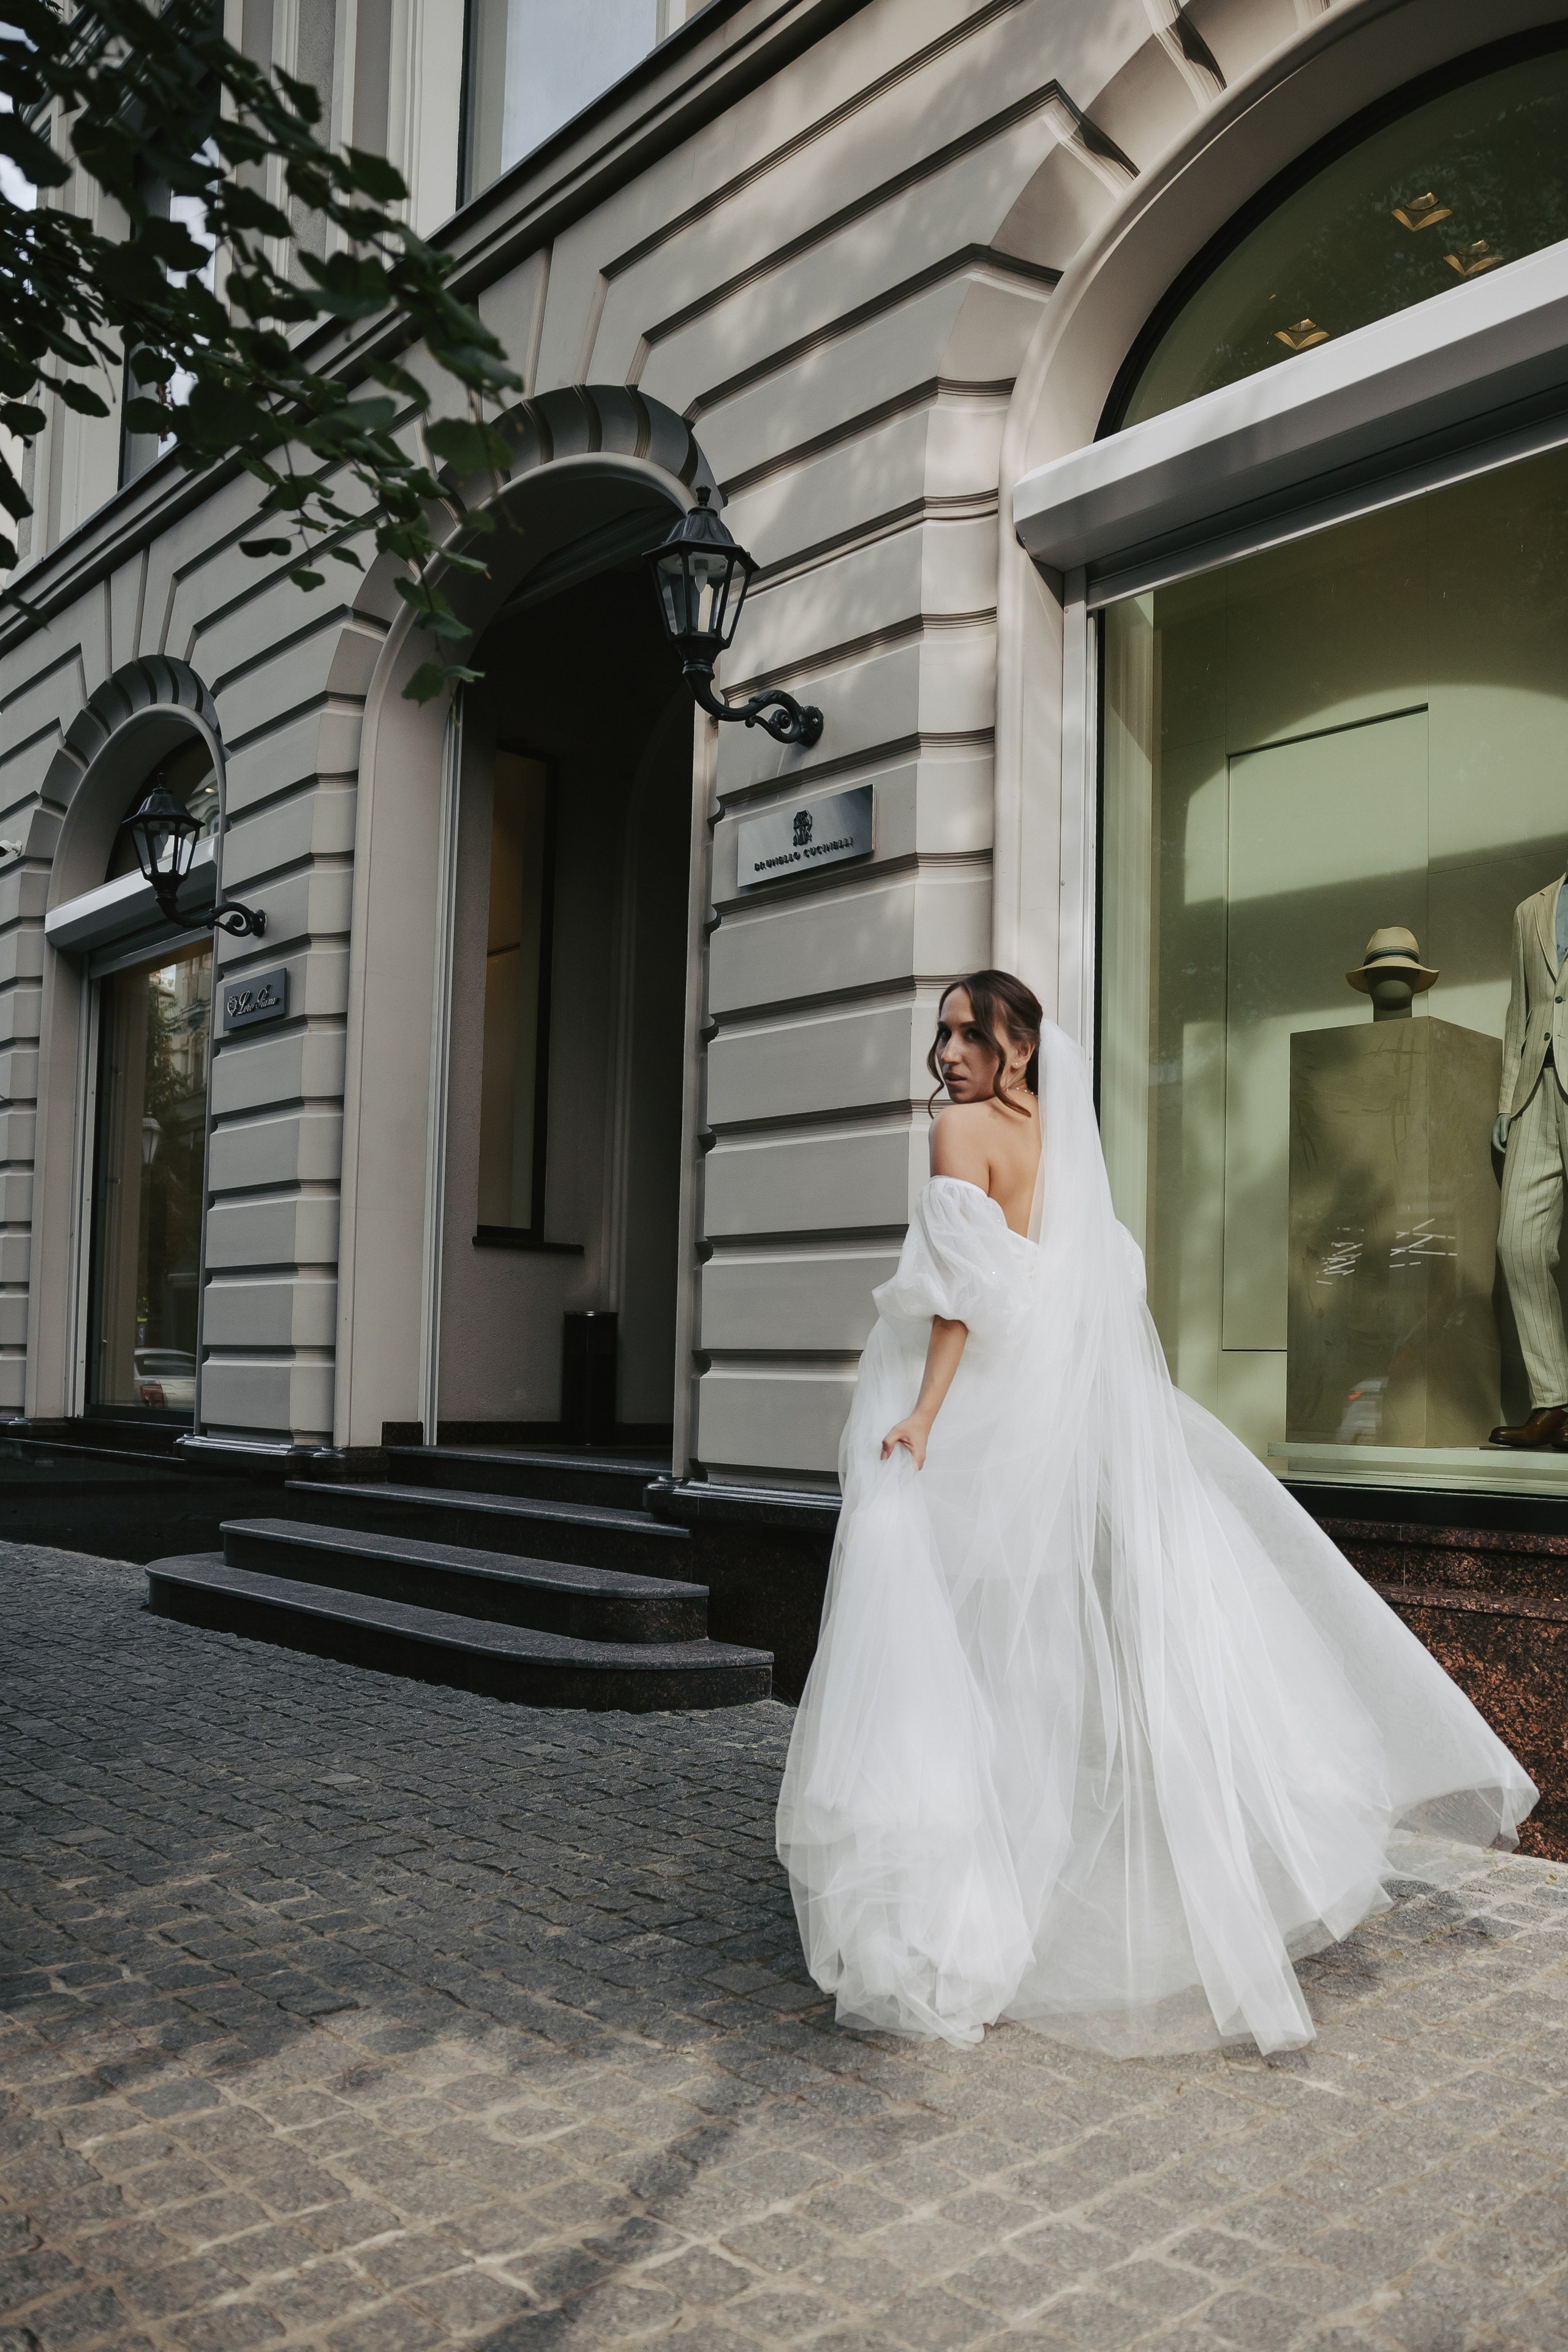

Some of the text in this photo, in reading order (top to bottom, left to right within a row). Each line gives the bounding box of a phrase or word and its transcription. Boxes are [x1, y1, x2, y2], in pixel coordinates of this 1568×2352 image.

[754, 837, 853, 871] BRUNELLO CUCINELLI
[236, 988, 276, 1015] Loro Piana
